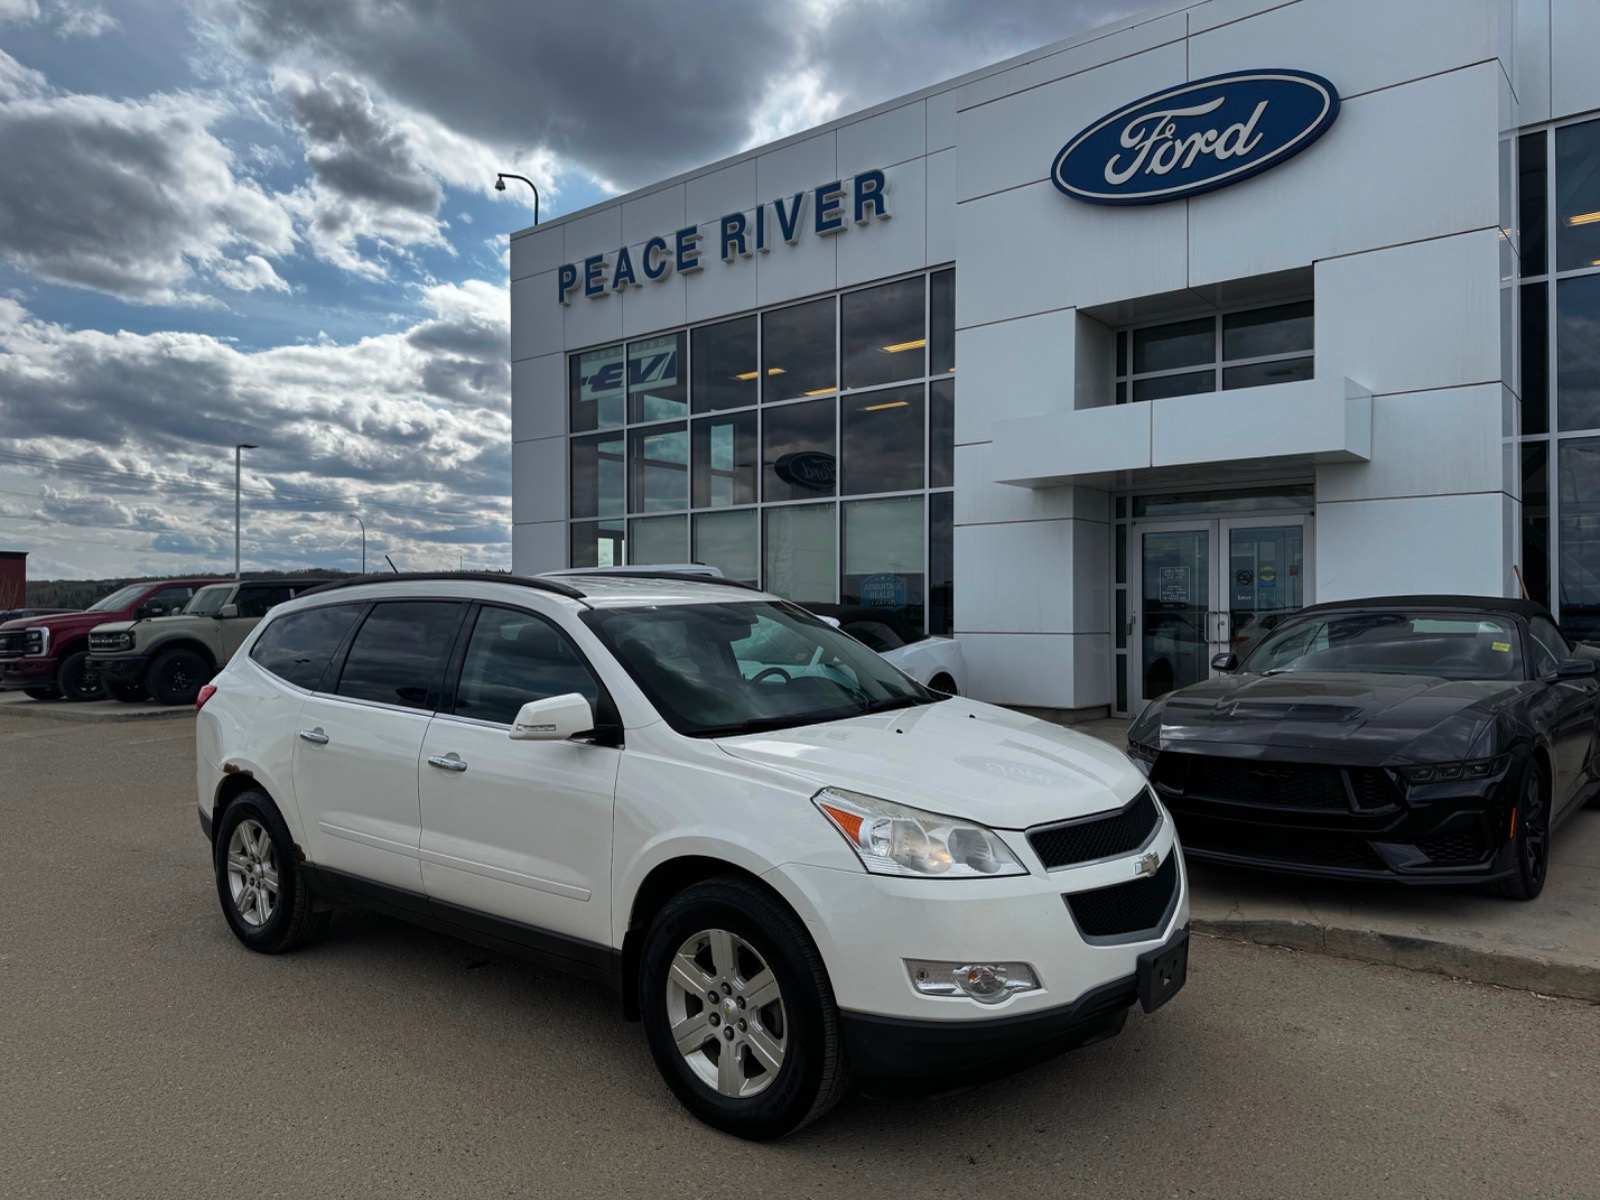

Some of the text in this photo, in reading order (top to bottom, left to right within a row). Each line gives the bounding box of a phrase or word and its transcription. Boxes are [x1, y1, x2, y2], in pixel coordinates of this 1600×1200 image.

[1104, 96, 1270, 186] Ford
[558, 168, 891, 305] PEACE RIVER
